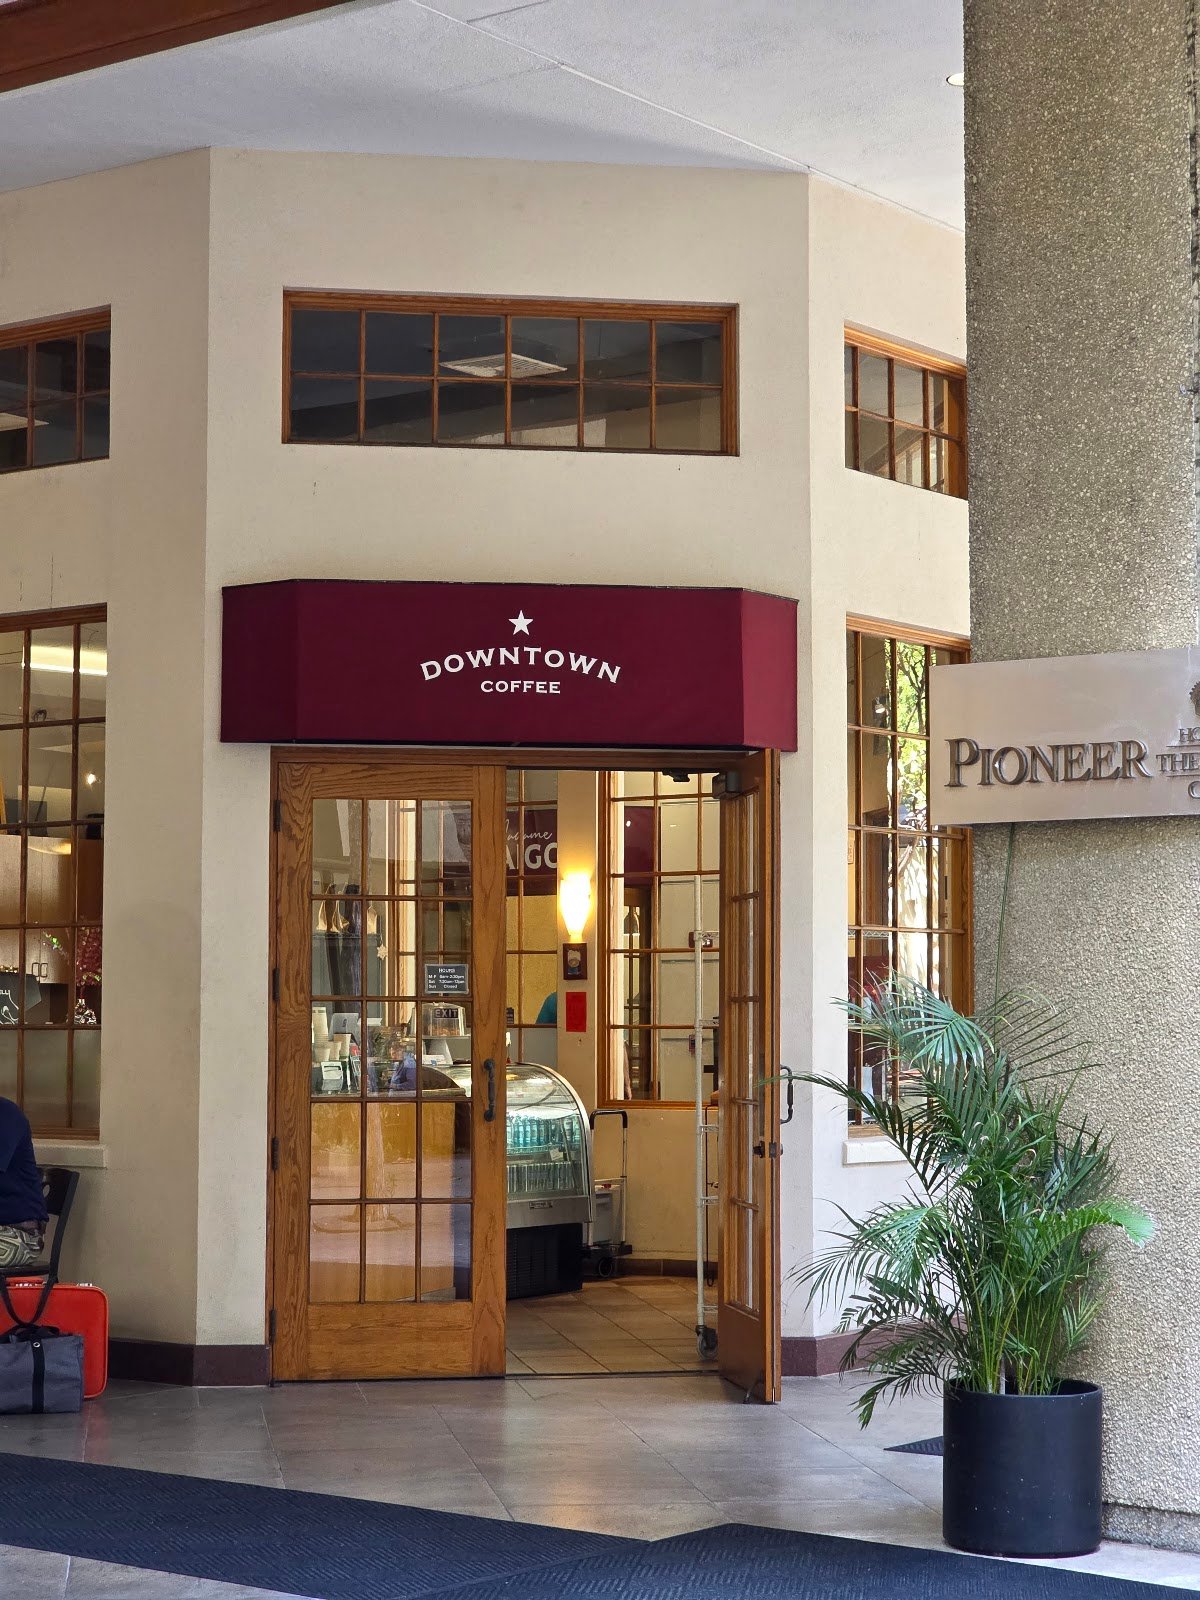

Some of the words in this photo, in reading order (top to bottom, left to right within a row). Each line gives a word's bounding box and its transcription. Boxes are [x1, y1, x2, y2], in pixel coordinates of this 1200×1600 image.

[420, 646, 621, 683] DOWNTOWN
[480, 680, 561, 694] COFFEE
[436, 1009, 457, 1017] EXIT
